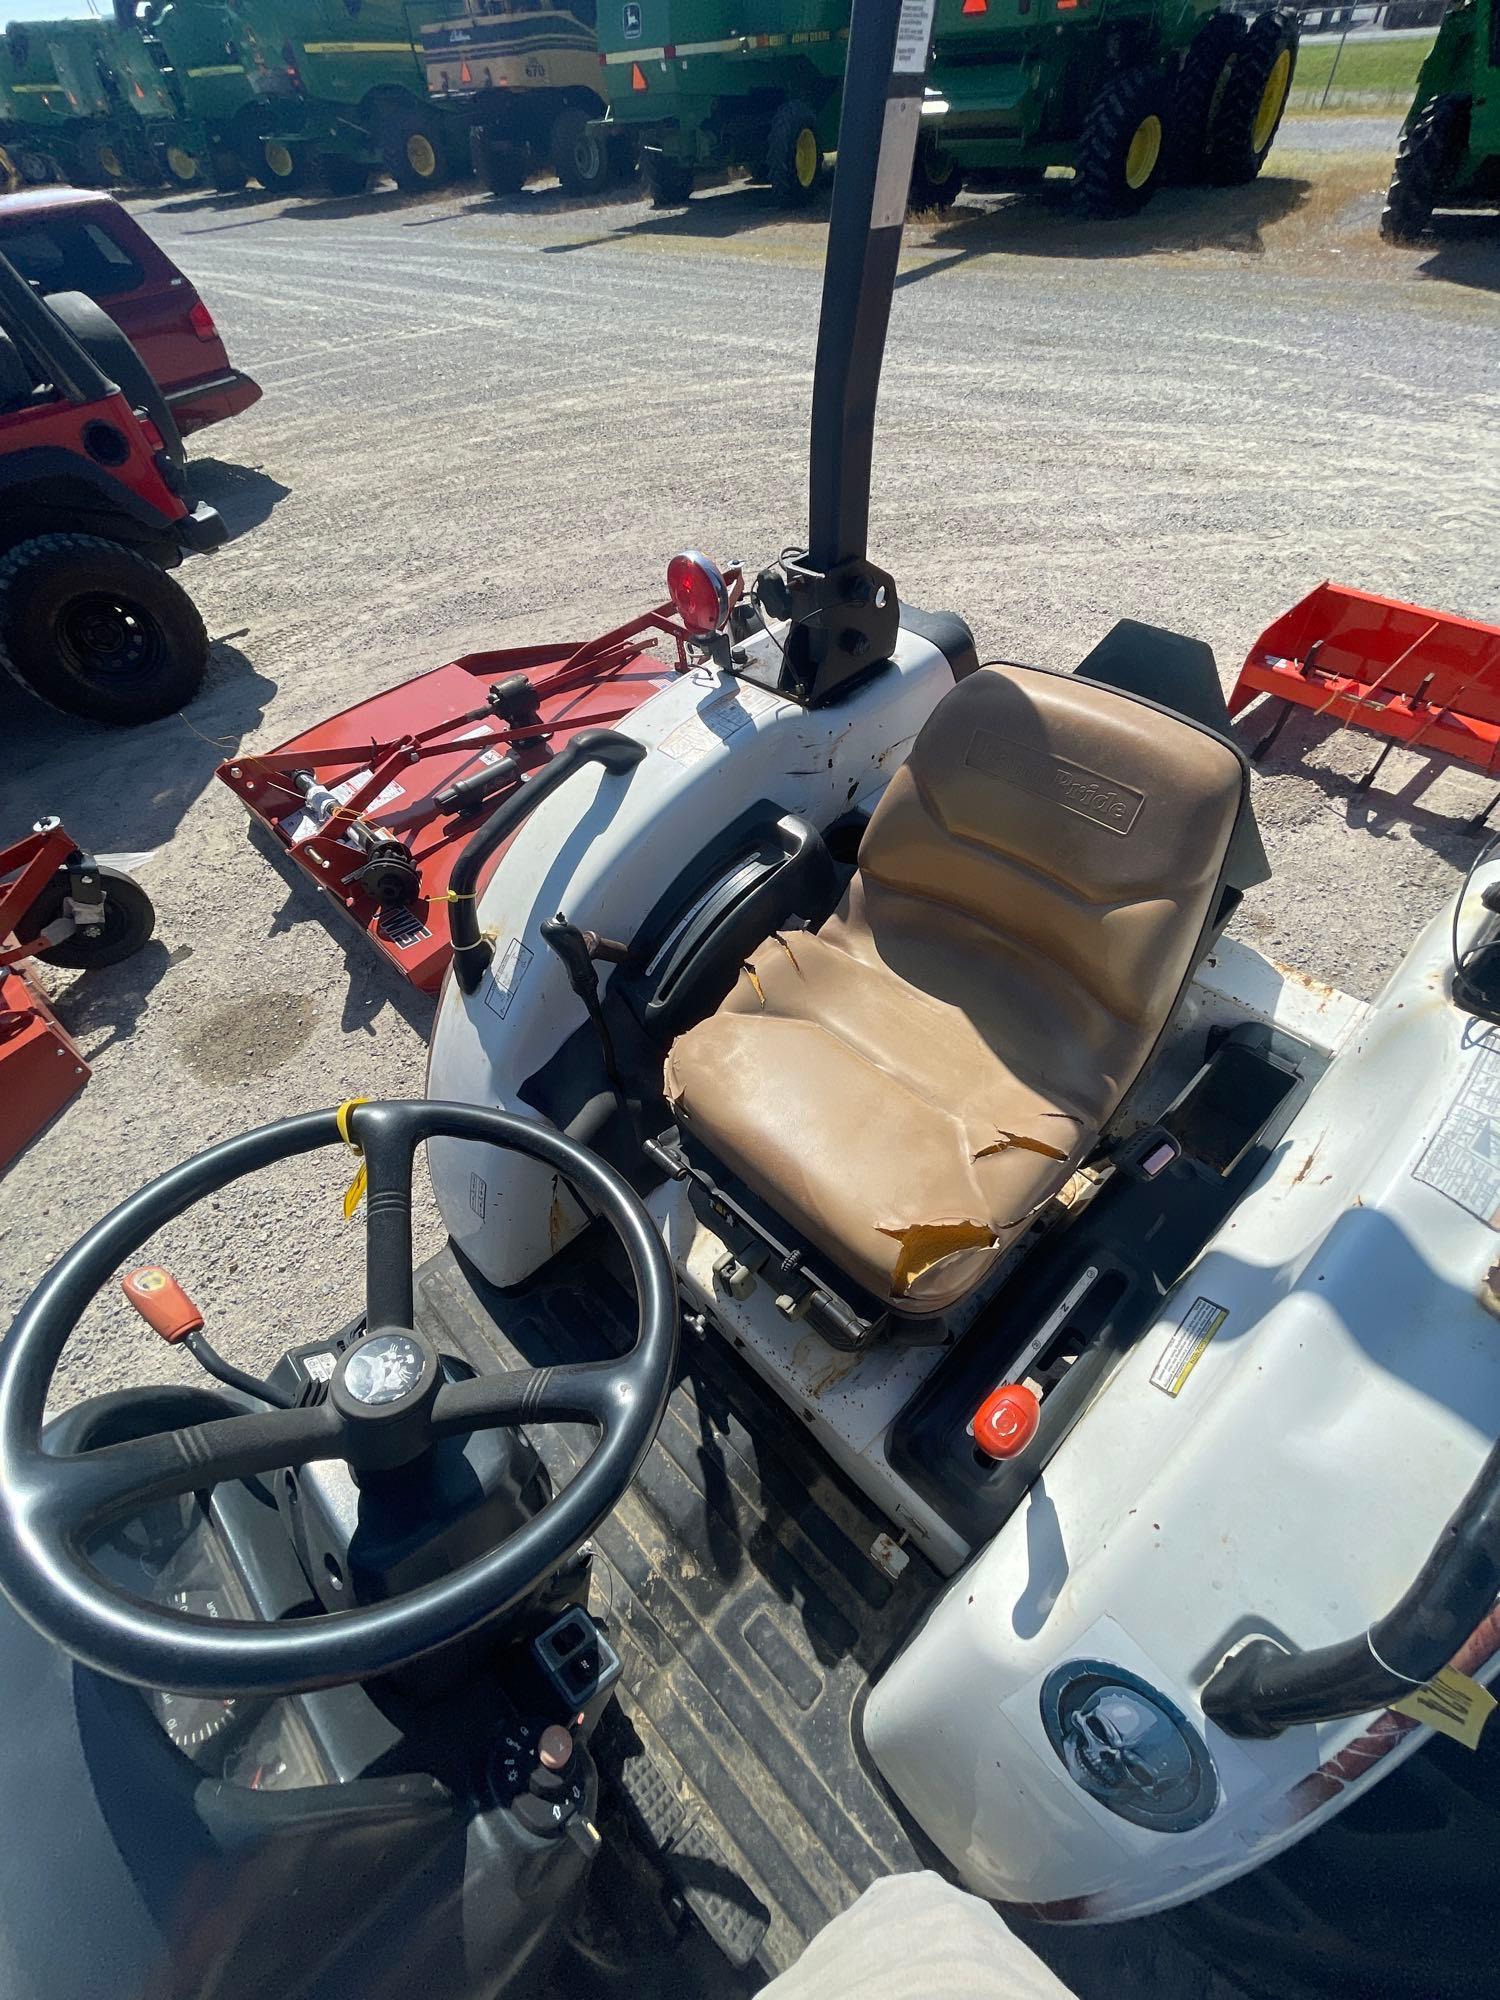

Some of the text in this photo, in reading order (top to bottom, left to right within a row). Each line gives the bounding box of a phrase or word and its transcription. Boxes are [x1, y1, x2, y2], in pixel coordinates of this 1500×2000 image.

[525, 64, 545, 77] 670
[1056, 769, 1127, 819] Pride
[166, 1718, 177, 1730] 10
